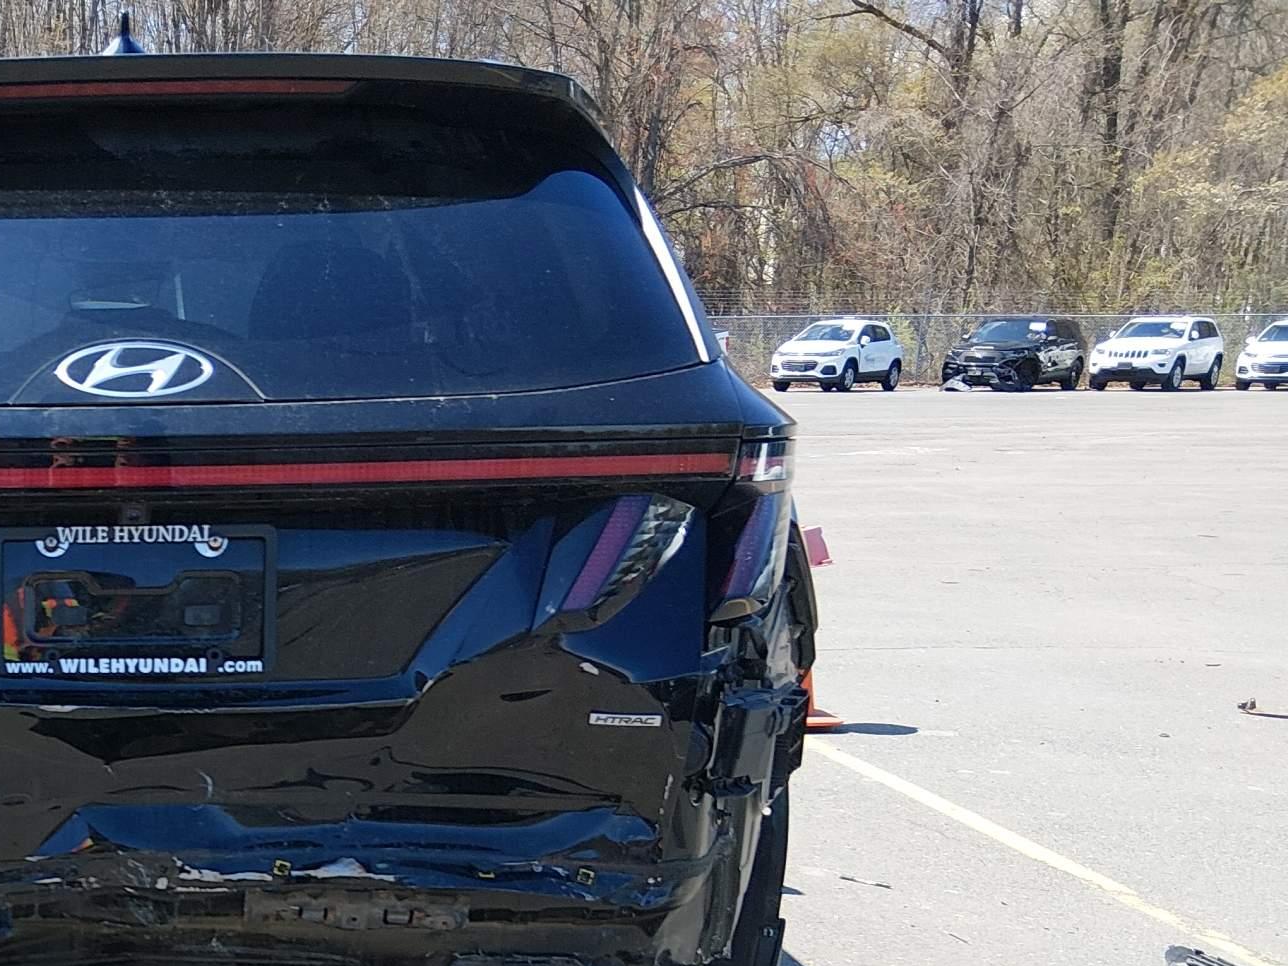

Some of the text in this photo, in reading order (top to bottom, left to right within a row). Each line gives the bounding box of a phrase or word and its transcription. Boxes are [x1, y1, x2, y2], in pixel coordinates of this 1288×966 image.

[56, 525, 211, 543] WILE HYUNDAI
[5, 658, 263, 673] www. WILEHYUNDAI .com
[595, 716, 657, 725] HTRAC
